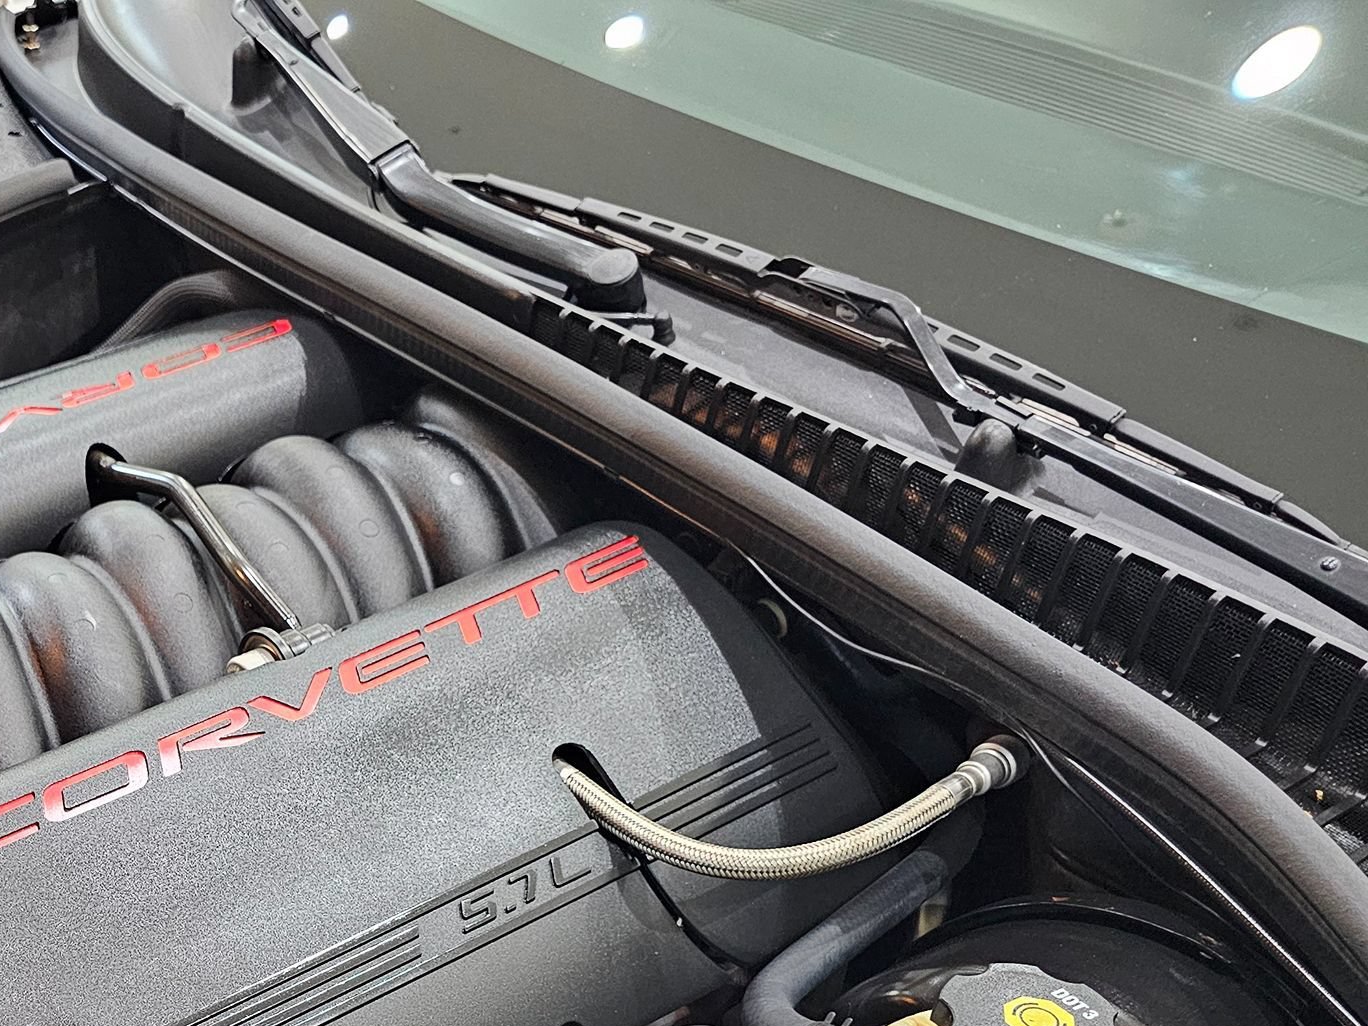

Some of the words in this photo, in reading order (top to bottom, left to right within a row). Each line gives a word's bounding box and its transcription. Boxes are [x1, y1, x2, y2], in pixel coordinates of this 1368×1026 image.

[459, 856, 593, 935] 5.7L
[1050, 987, 1090, 1011] DOT
[1082, 1009, 1099, 1020] 3
